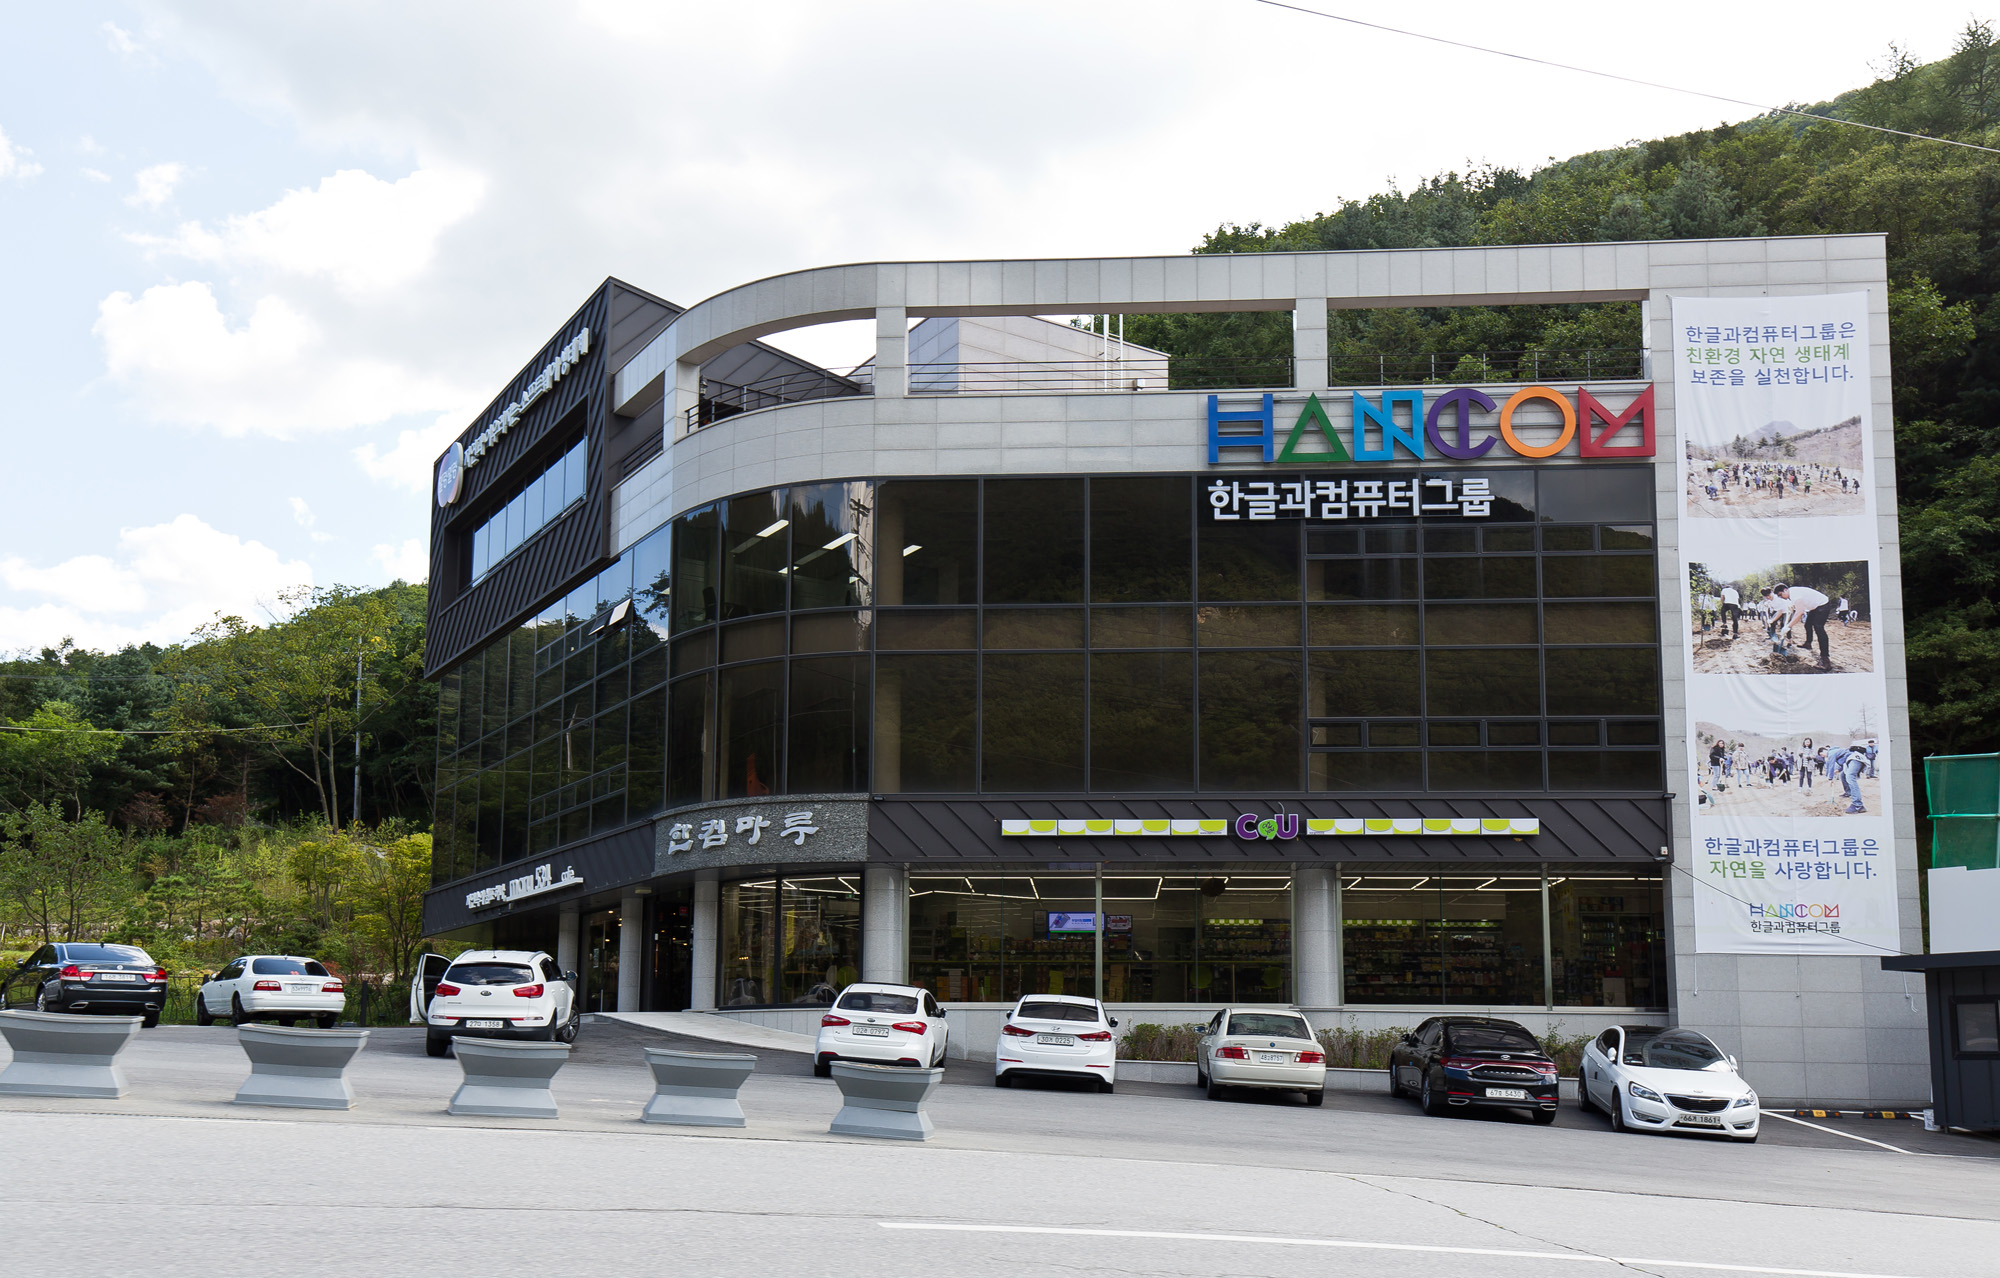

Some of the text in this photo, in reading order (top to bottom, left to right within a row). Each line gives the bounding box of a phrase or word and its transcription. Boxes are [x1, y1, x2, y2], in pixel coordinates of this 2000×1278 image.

[1685, 321, 1857, 345] 한글과컴퓨터그룹은
[1686, 342, 1850, 365] 친환경 자연 생태계
[1690, 364, 1854, 386] 보존을 실천합니다.
[1207, 384, 1656, 464] HANCOM
[1208, 478, 1495, 520] 한글과컴퓨터그룹
[667, 811, 820, 855] 한컴마루
[1235, 813, 1299, 840] CU
[1704, 837, 1880, 858] 한글과컴퓨터그룹은
[1709, 860, 1878, 880] 자연을 사랑합니다.
[1749, 903, 1840, 918] HANCOM
[1750, 920, 1841, 934] 한글과컴퓨터그룹
